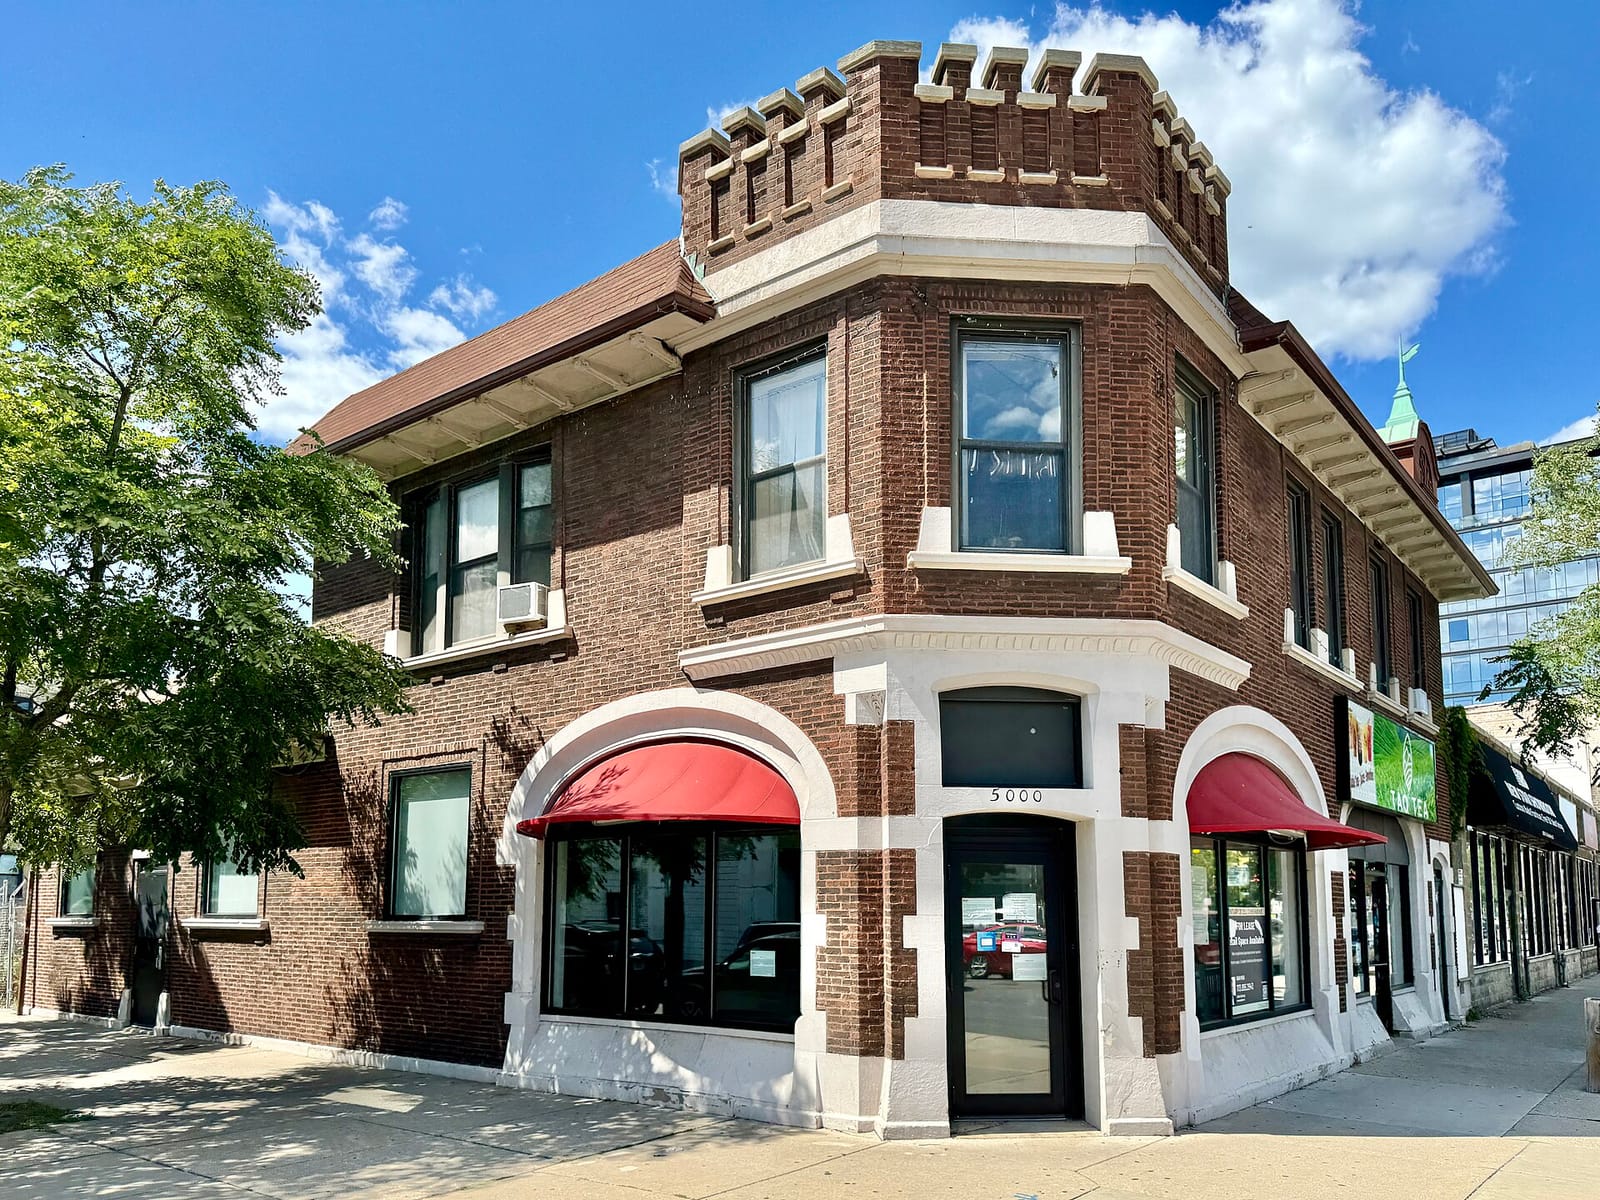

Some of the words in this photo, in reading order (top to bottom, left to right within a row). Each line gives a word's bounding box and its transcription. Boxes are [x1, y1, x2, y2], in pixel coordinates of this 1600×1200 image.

[990, 788, 1042, 802] 5000
[1390, 790, 1409, 814] TAO
[1411, 796, 1430, 819] TEA
[1243, 921, 1255, 931] LEASE
